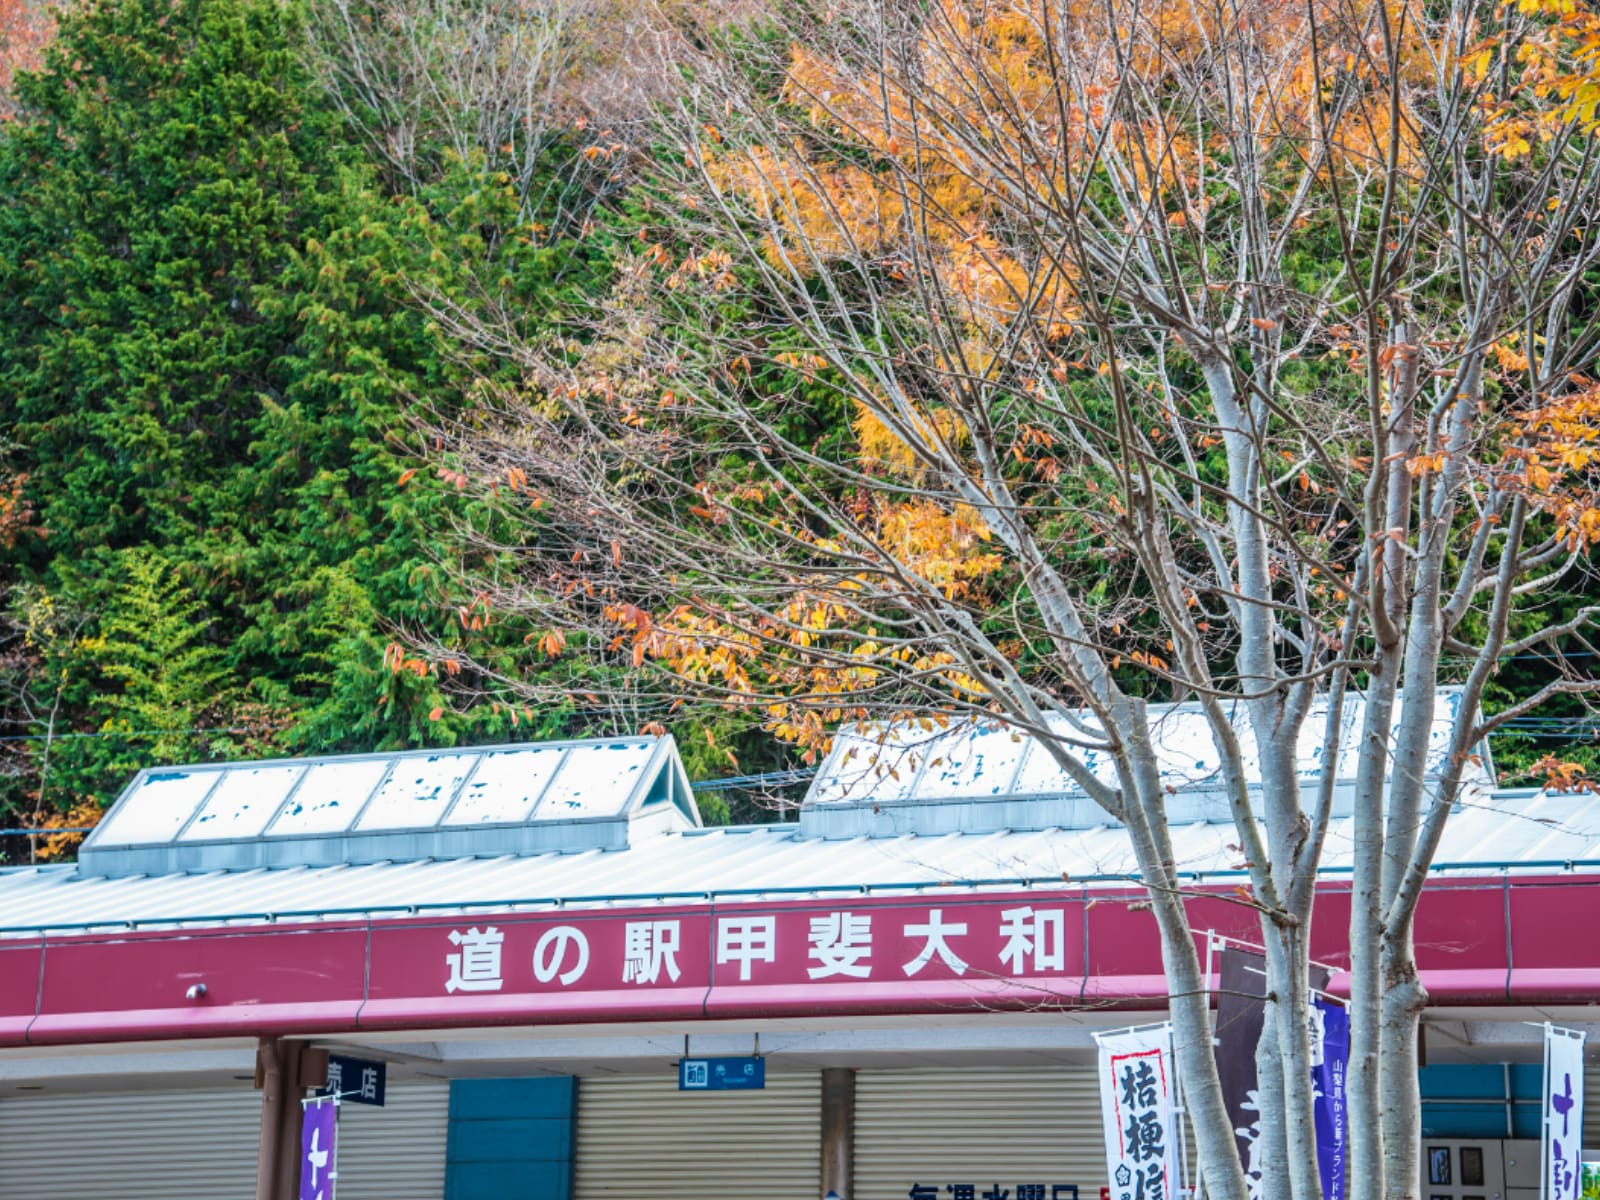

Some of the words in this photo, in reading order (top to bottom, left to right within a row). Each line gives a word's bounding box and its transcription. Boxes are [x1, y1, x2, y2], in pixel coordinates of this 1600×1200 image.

[445, 906, 1065, 994] 道の駅甲斐大和
[326, 1062, 377, 1099] 売店
